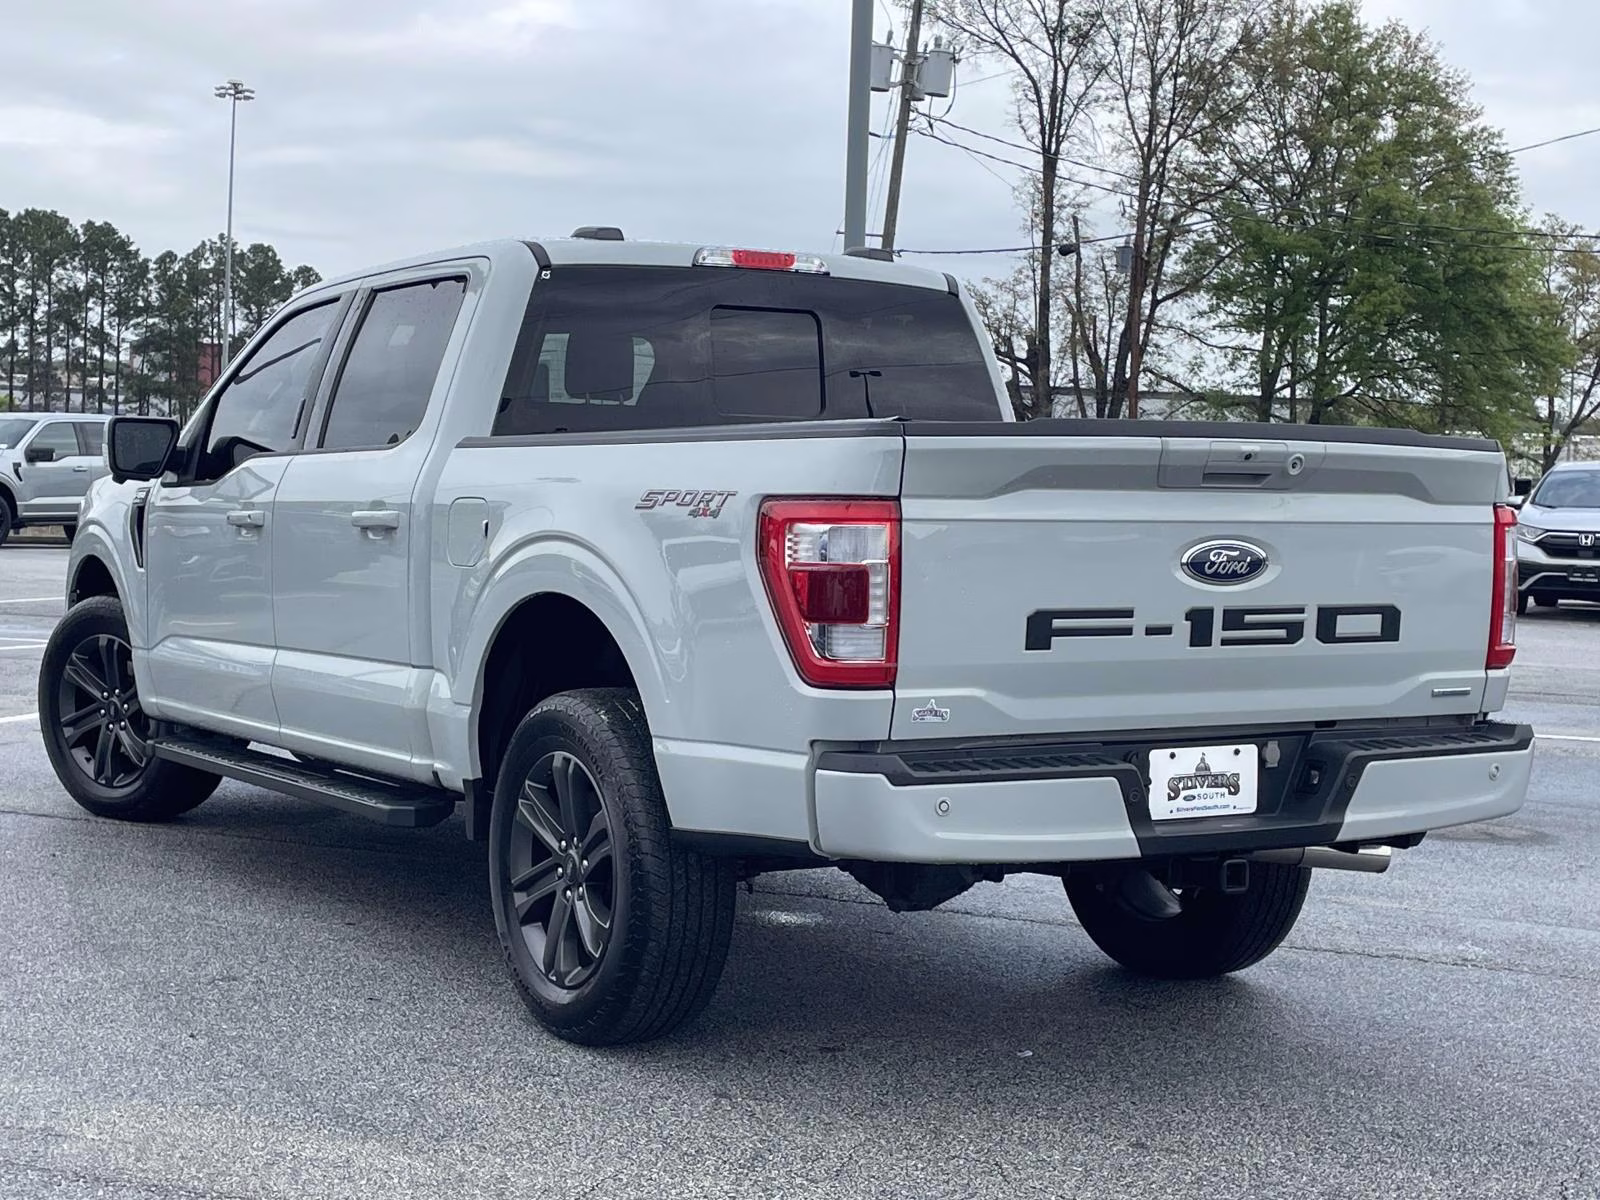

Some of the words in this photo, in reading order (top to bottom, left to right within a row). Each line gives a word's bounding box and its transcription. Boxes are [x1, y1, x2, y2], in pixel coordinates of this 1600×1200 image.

[634, 489, 738, 510] SPORT
[1204, 549, 1251, 576] Ford
[1024, 603, 1402, 652] F-150
[1167, 773, 1240, 801] STIVERS
[1197, 792, 1226, 800] SOUTH
